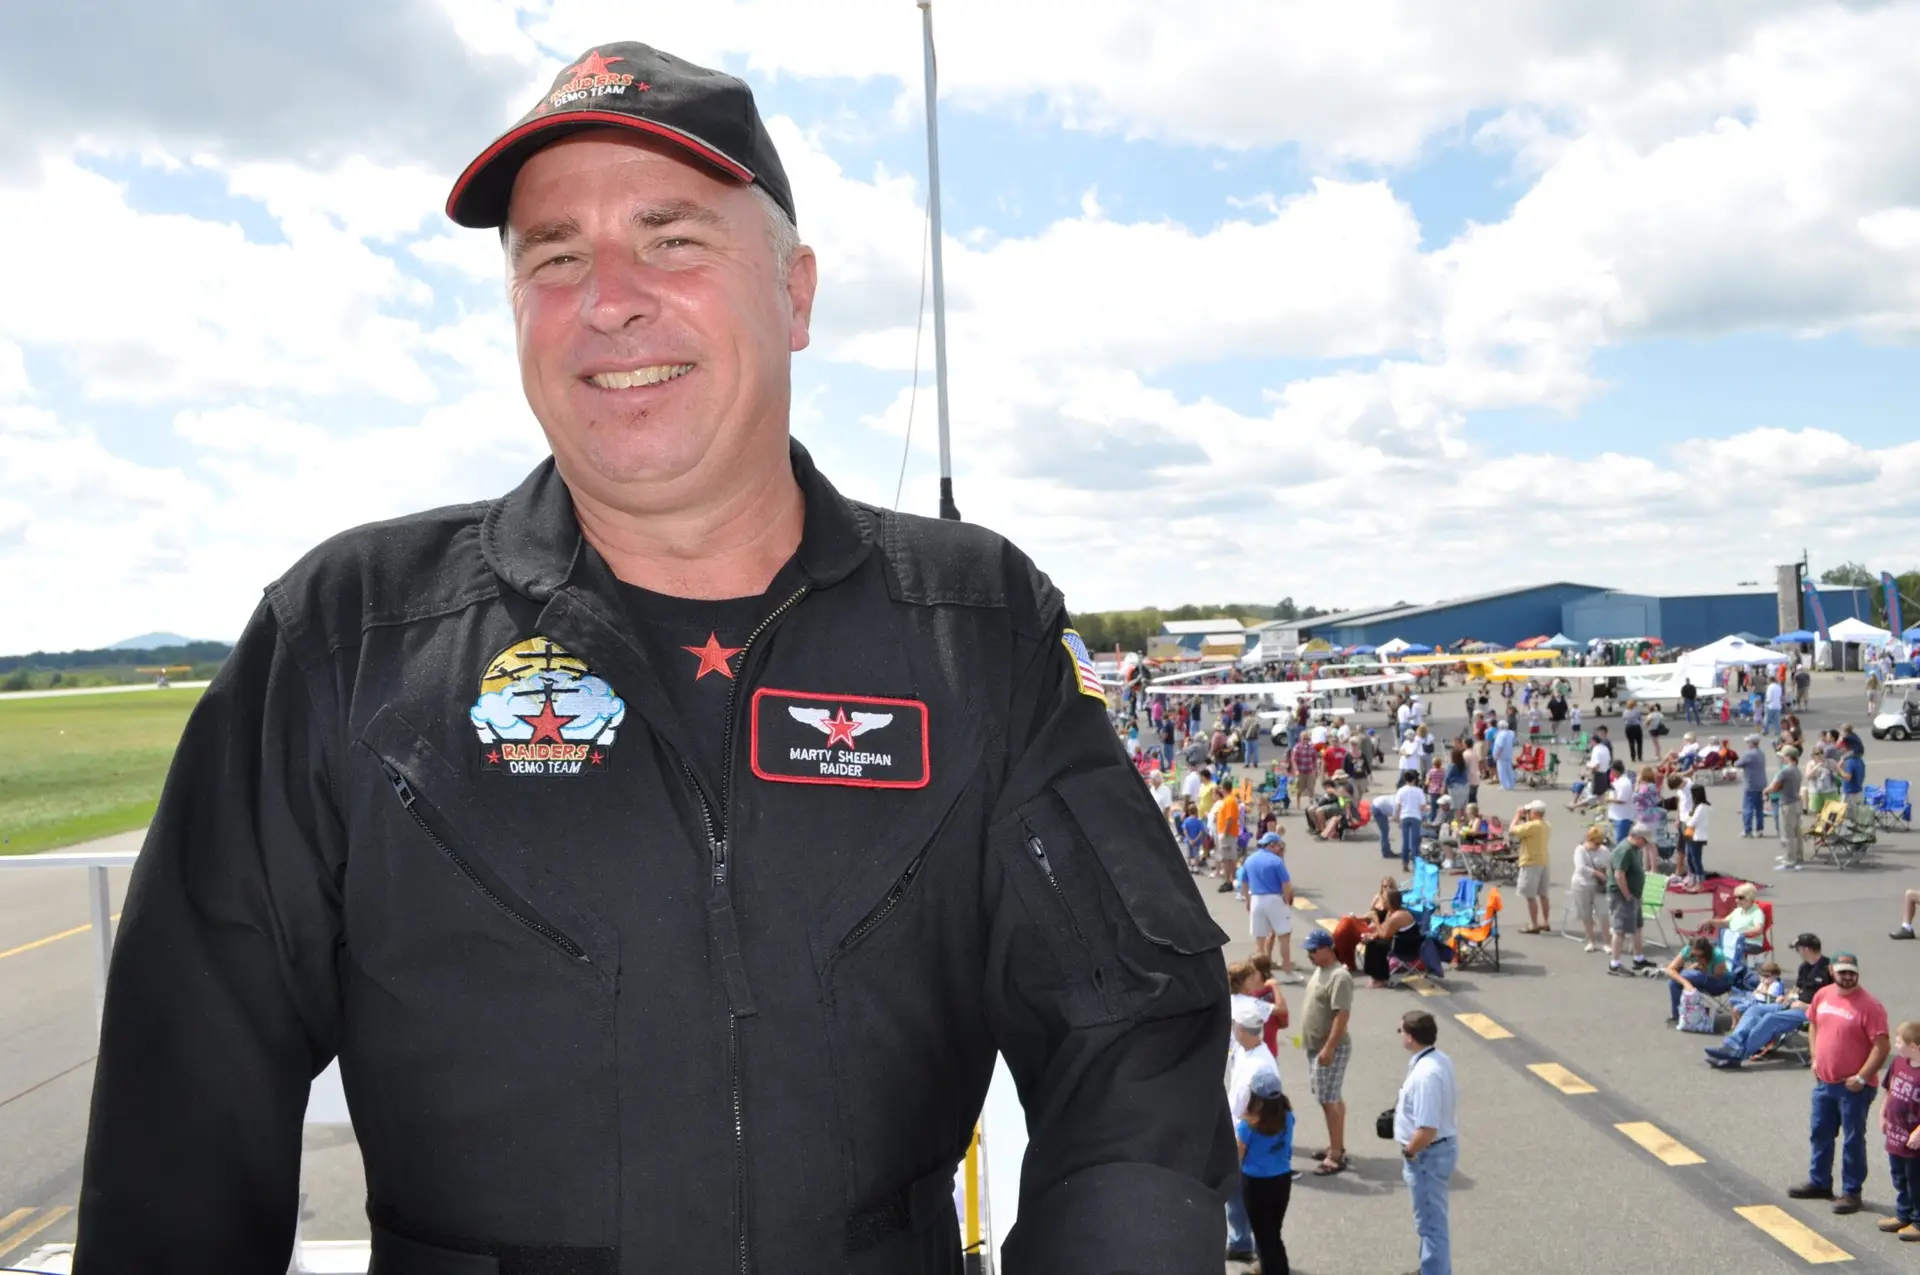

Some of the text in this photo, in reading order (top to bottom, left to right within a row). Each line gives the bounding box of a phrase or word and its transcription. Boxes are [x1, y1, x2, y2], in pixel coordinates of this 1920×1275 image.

[551, 73, 634, 103] RAIDERS
[555, 86, 625, 108] DEMO TEAM
[502, 744, 589, 760] RAIDERS
[790, 748, 891, 766] MARTY SHEEHAN
[510, 761, 582, 773] DEMO TEAM
[820, 763, 862, 776] RAIDER
